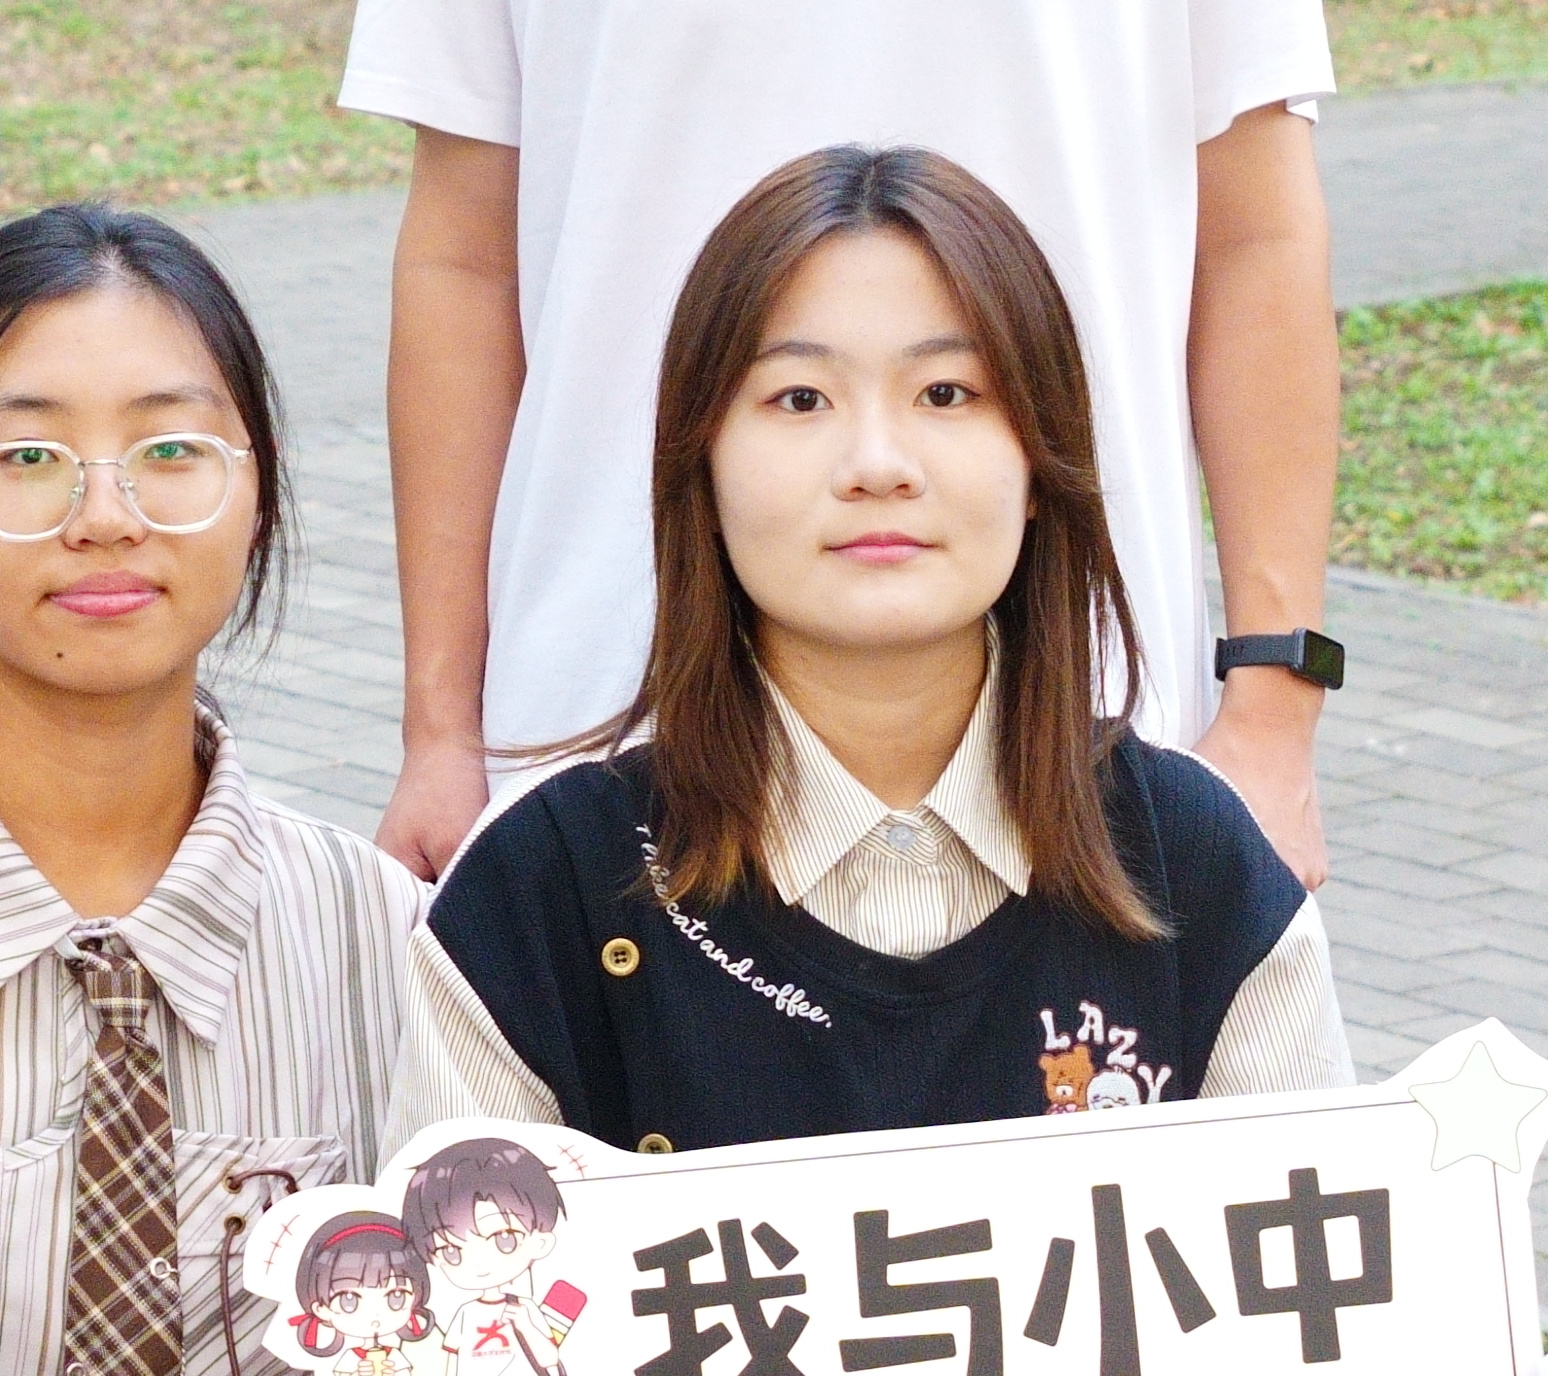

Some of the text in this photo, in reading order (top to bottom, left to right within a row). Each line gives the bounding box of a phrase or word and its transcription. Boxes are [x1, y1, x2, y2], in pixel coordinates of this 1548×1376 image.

[666, 901, 708, 941] cat
[700, 938, 755, 982] and
[751, 975, 833, 1029] coffee.
[1038, 1000, 1174, 1105] LAZY
